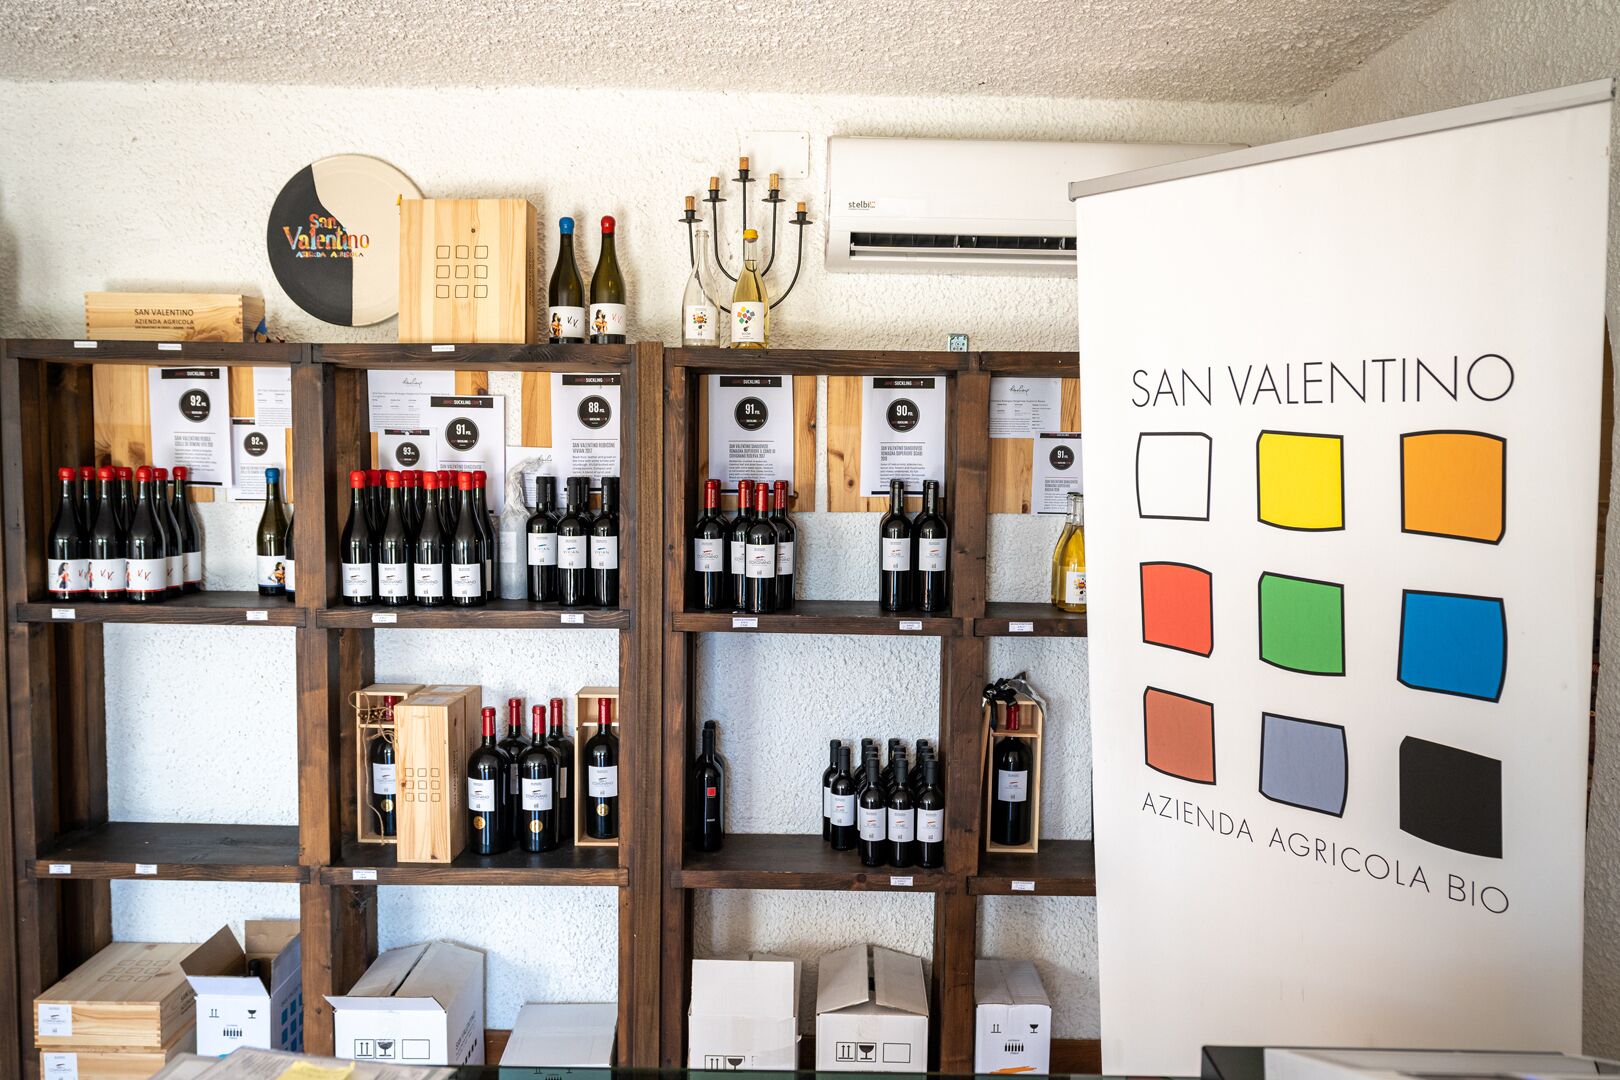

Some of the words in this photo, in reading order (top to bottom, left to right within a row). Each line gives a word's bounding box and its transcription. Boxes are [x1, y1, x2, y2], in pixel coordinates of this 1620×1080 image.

[309, 213, 336, 229] San
[282, 226, 369, 250] Valentino
[1132, 366, 1212, 408] SAN
[1228, 353, 1514, 406] VALENTINO
[190, 395, 201, 406] 92
[588, 402, 599, 413] 88
[745, 404, 754, 414] 91
[896, 405, 908, 416] 90
[456, 424, 466, 435] 91
[251, 437, 260, 445] 92
[402, 447, 411, 455] 93
[1057, 450, 1064, 459] 91
[1142, 792, 1254, 843] AZIENDA
[1268, 827, 1430, 894] AGRICOLA
[1448, 873, 1509, 914] BIO
